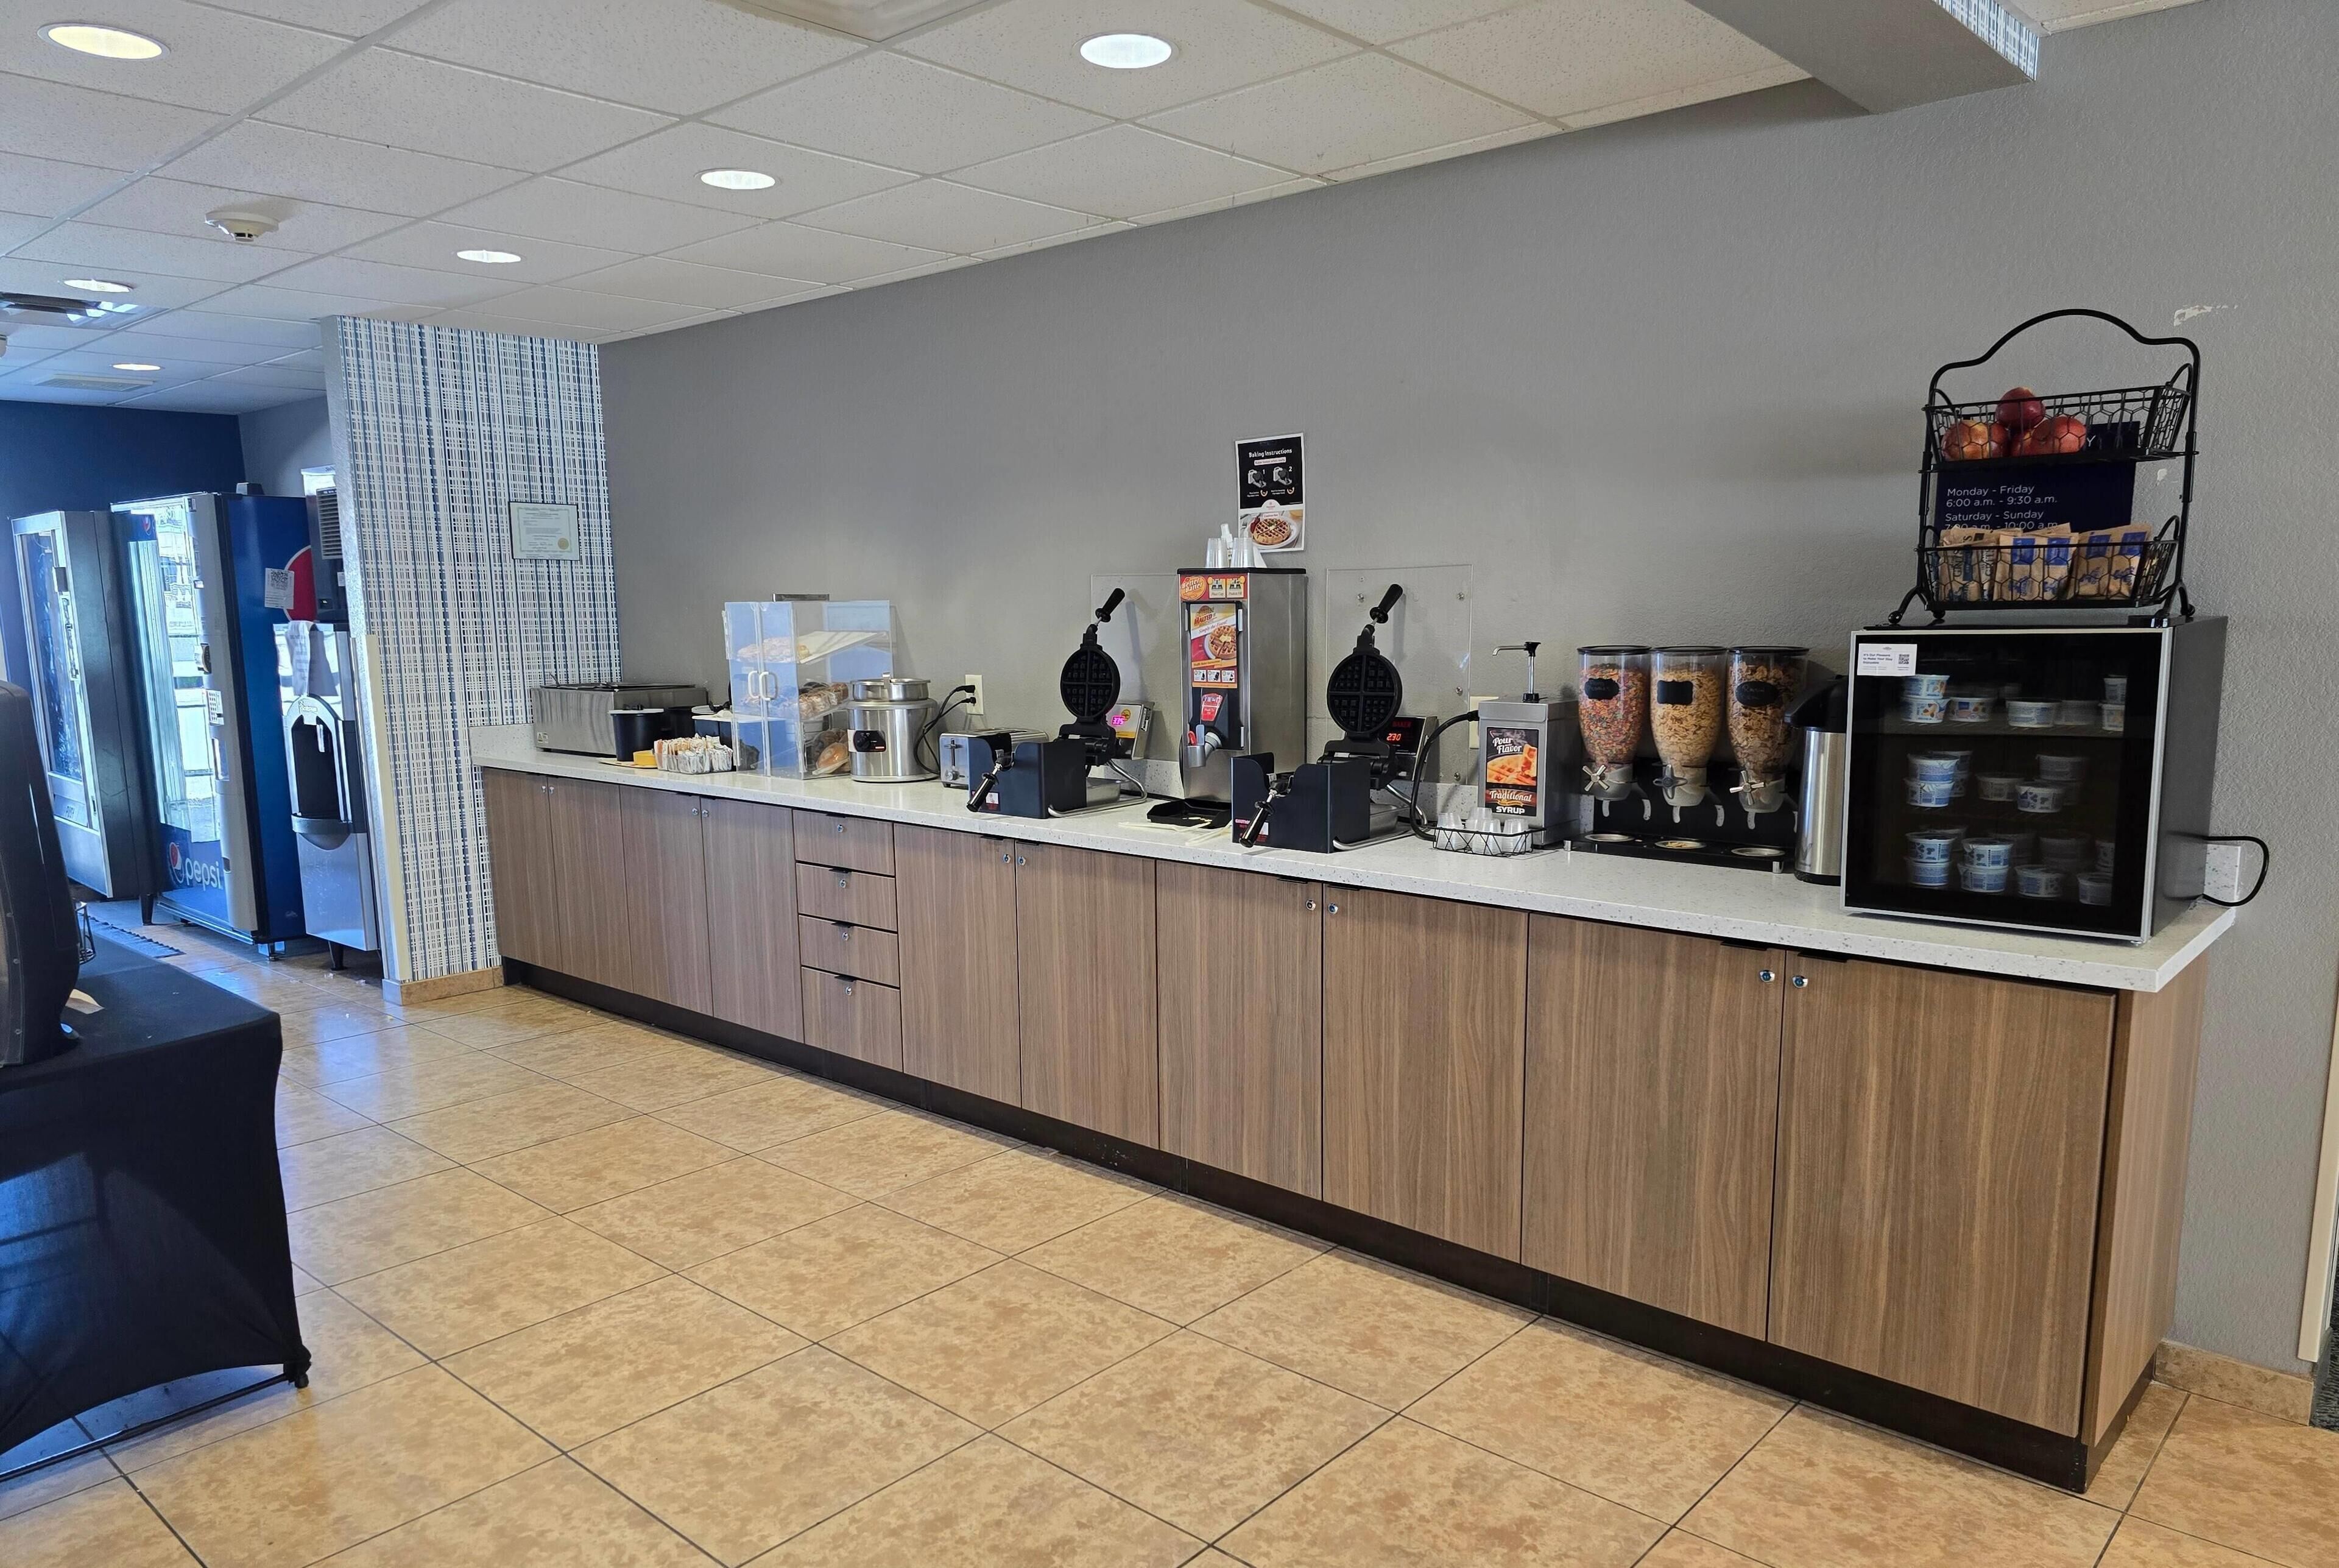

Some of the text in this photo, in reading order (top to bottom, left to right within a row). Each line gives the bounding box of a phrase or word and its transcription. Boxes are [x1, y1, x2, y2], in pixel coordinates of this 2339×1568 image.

[1947, 487, 1989, 496] Monday
[2000, 485, 2035, 495] Friday
[1946, 498, 1971, 507] 6:00
[2007, 496, 2031, 505] 9:30
[1945, 512, 1992, 521] Saturday
[2003, 510, 2044, 520] Sunday
[1194, 614, 1213, 625] MALTED
[1492, 737, 1513, 747] Pour
[1497, 744, 1522, 754] Flavor
[1489, 789, 1533, 802] Traditional
[1496, 806, 1525, 814] SYRUP
[185, 858, 222, 891] pepsi
